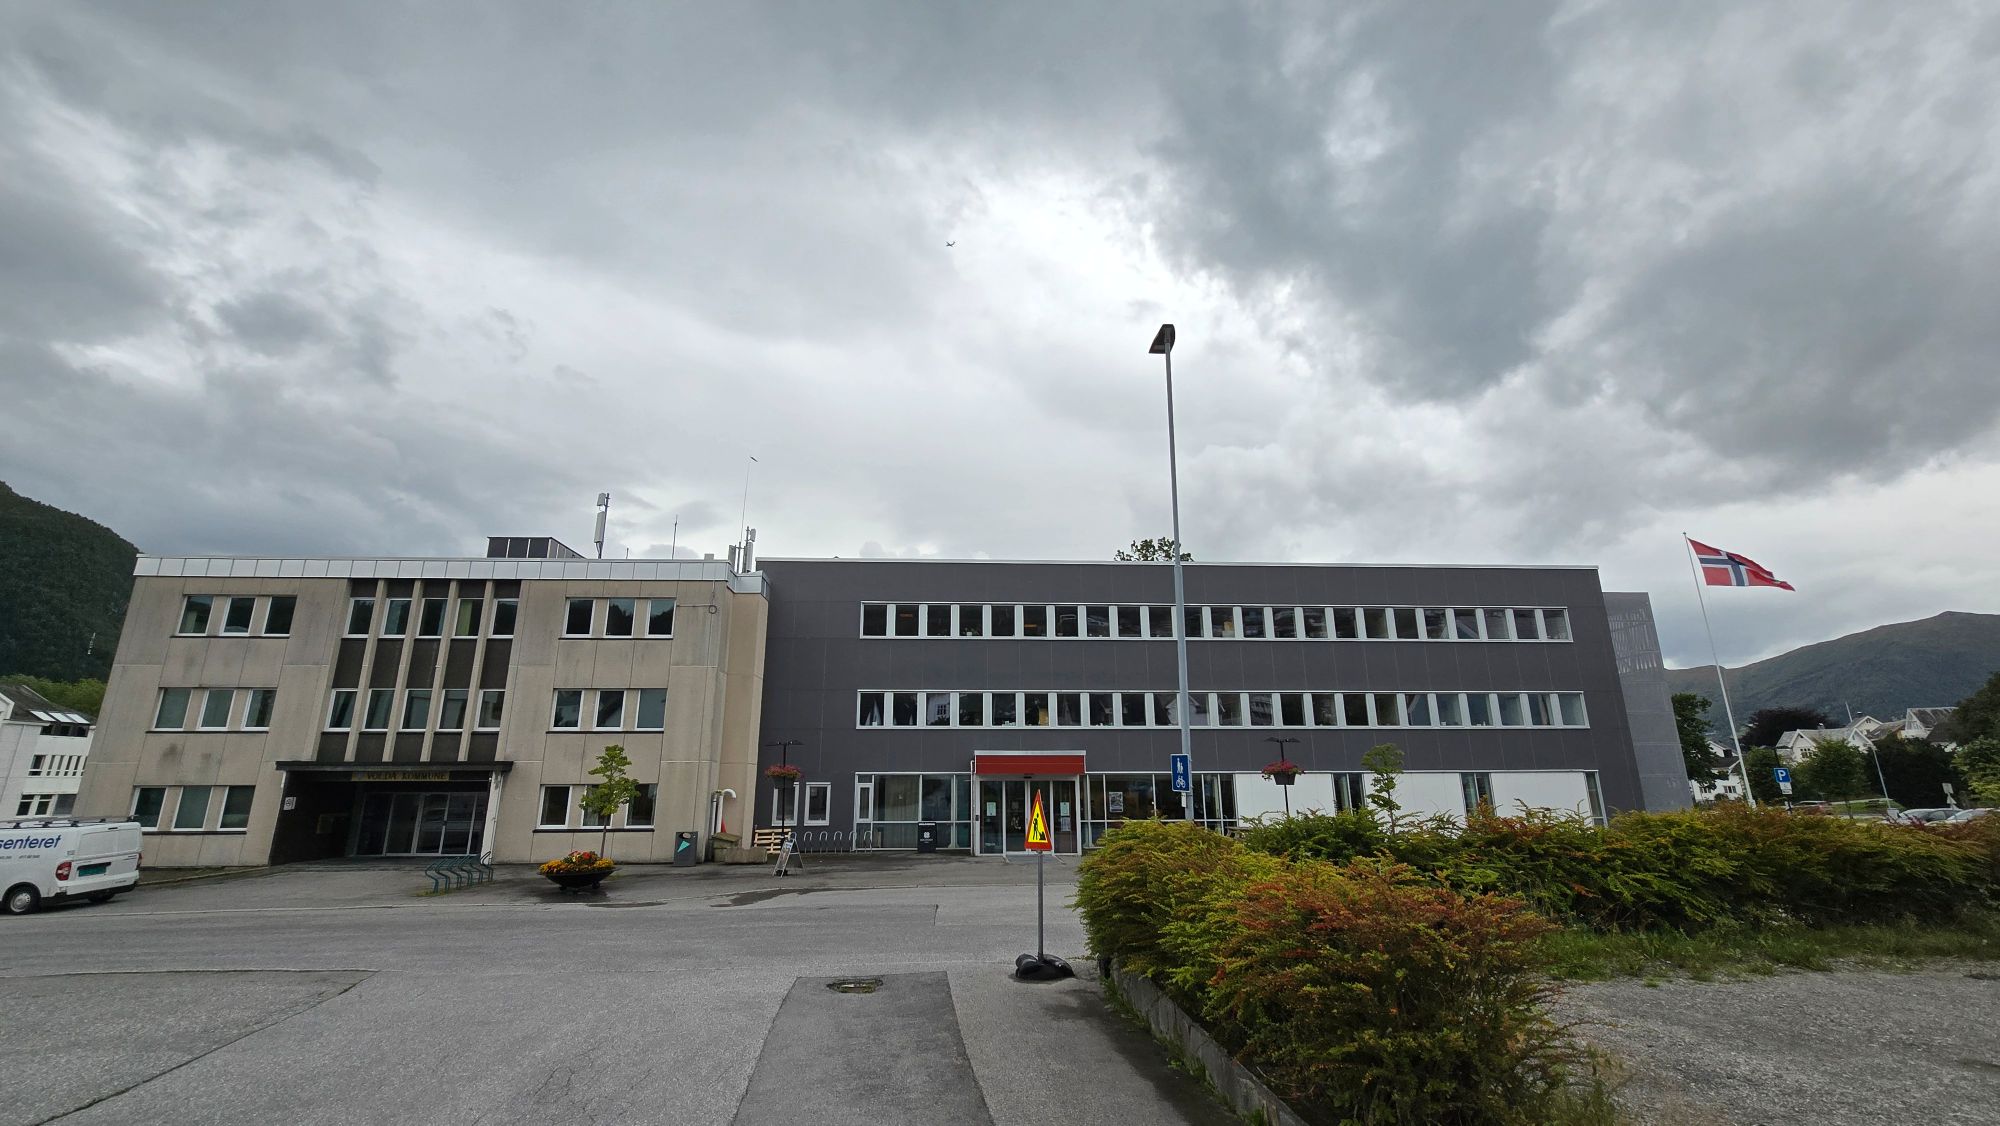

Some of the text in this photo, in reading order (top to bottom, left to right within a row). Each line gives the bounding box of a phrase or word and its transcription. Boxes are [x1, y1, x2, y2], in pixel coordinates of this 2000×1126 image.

[367, 771, 448, 780] VOLDA KOMMUNE
[1777, 769, 1786, 781] P
